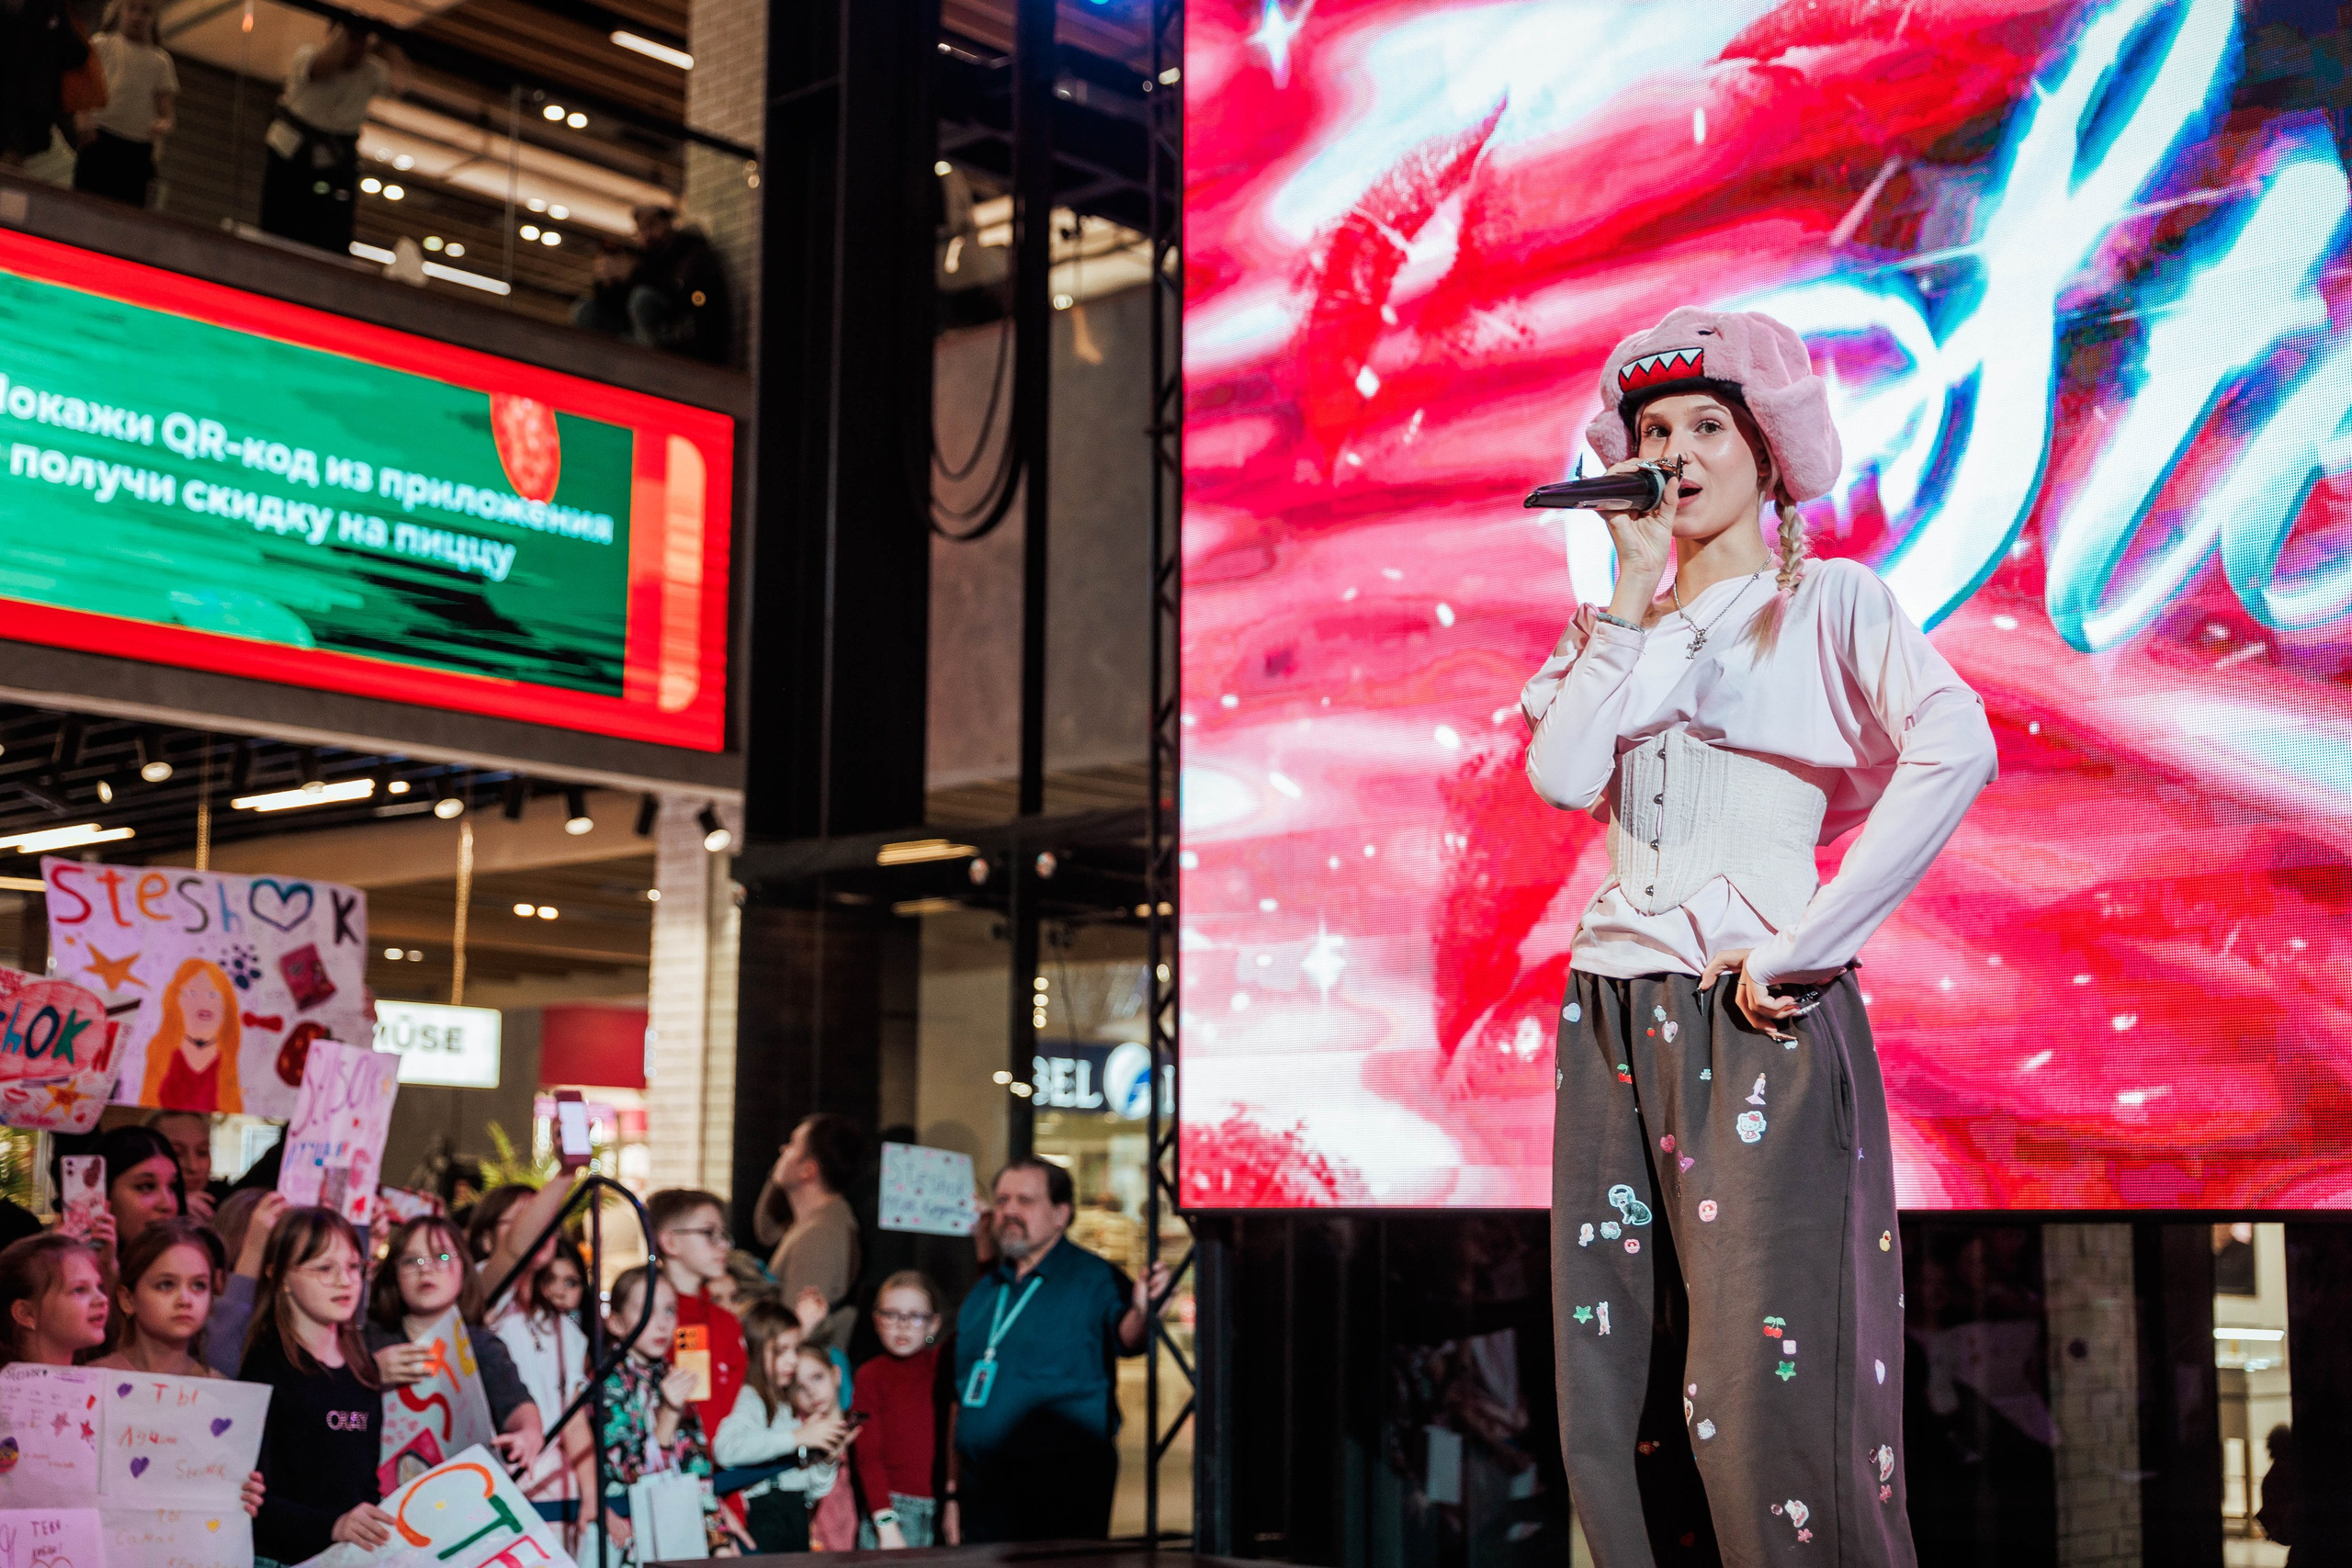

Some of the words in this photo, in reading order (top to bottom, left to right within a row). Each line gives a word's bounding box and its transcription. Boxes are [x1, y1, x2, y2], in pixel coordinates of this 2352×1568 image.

[9, 442, 176, 503] получи
[182, 479, 334, 545] скидку
[338, 511, 389, 549] на
[393, 521, 516, 582] пиццу
[161, 412, 320, 488] QR-код
[325, 455, 374, 492] из
[379, 466, 614, 546] приложения
[0, 999, 92, 1065] hOK
